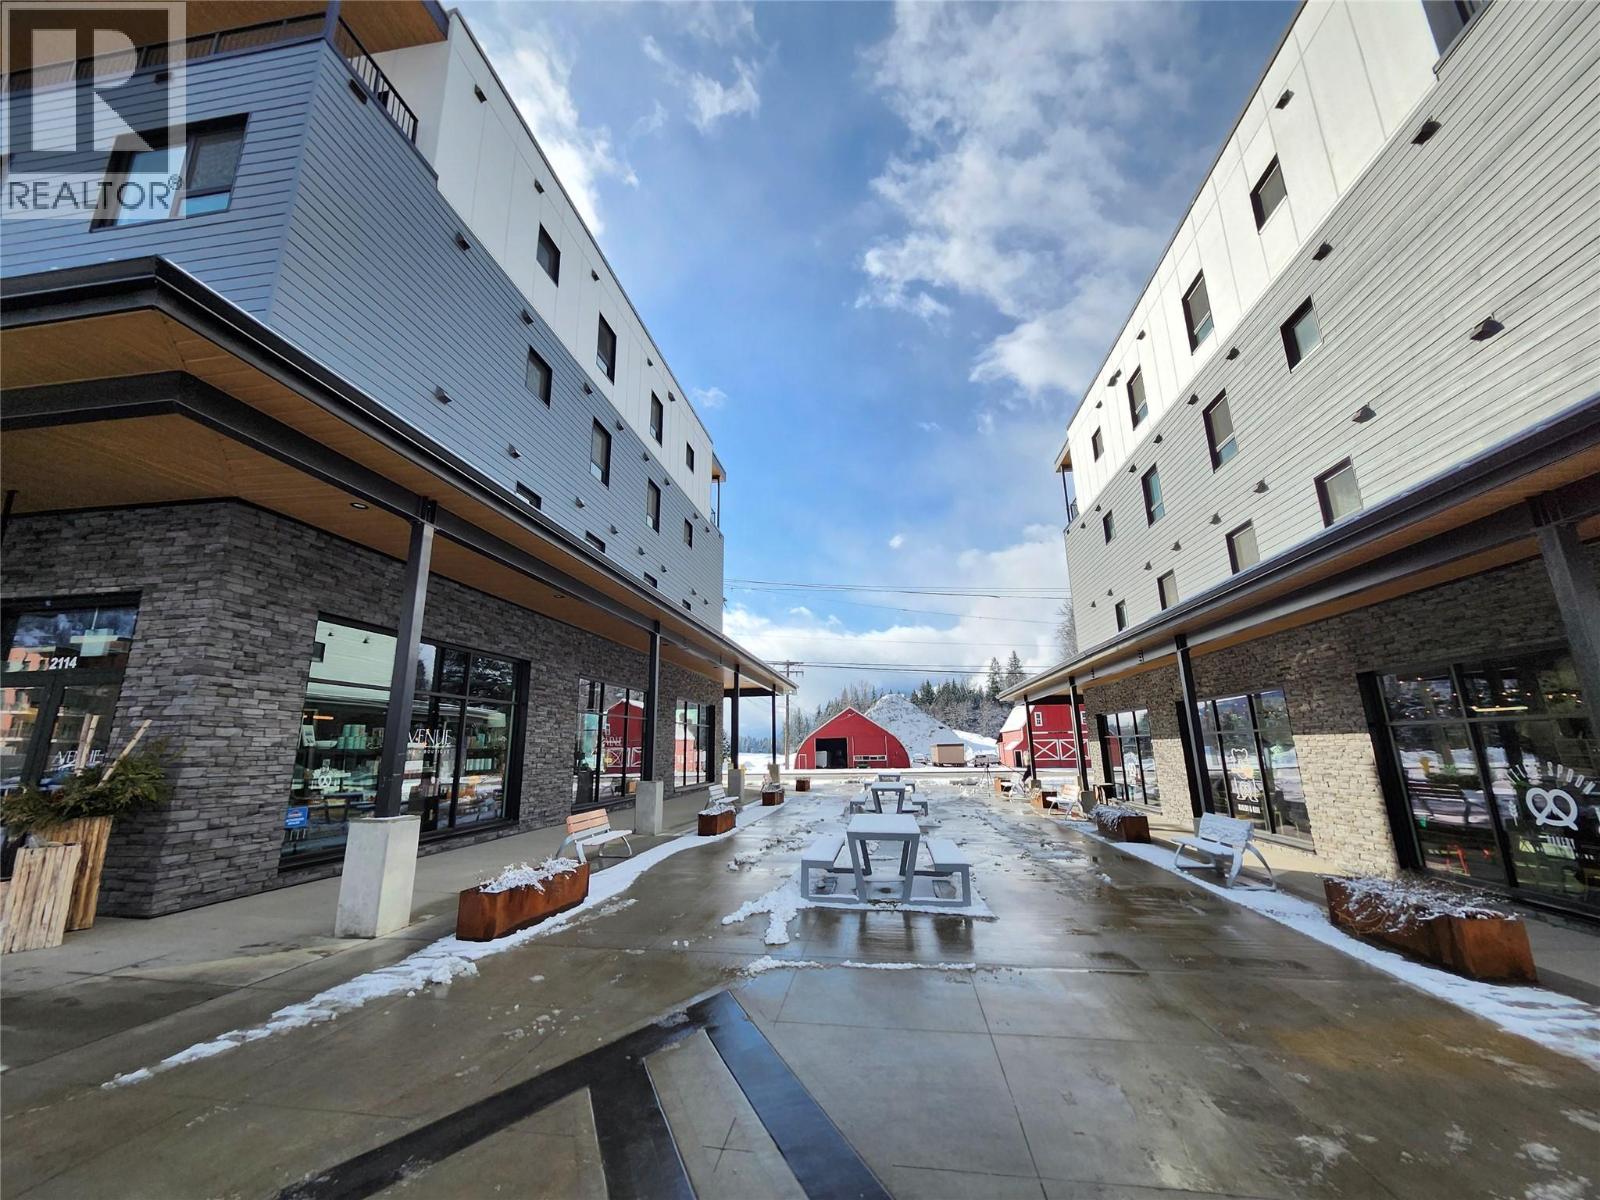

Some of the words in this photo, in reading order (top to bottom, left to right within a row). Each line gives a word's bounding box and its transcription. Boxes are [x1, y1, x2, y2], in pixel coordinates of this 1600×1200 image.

[49, 656, 77, 669] 2114
[408, 729, 452, 746] VENUE
[1546, 761, 1596, 795] SPOON
